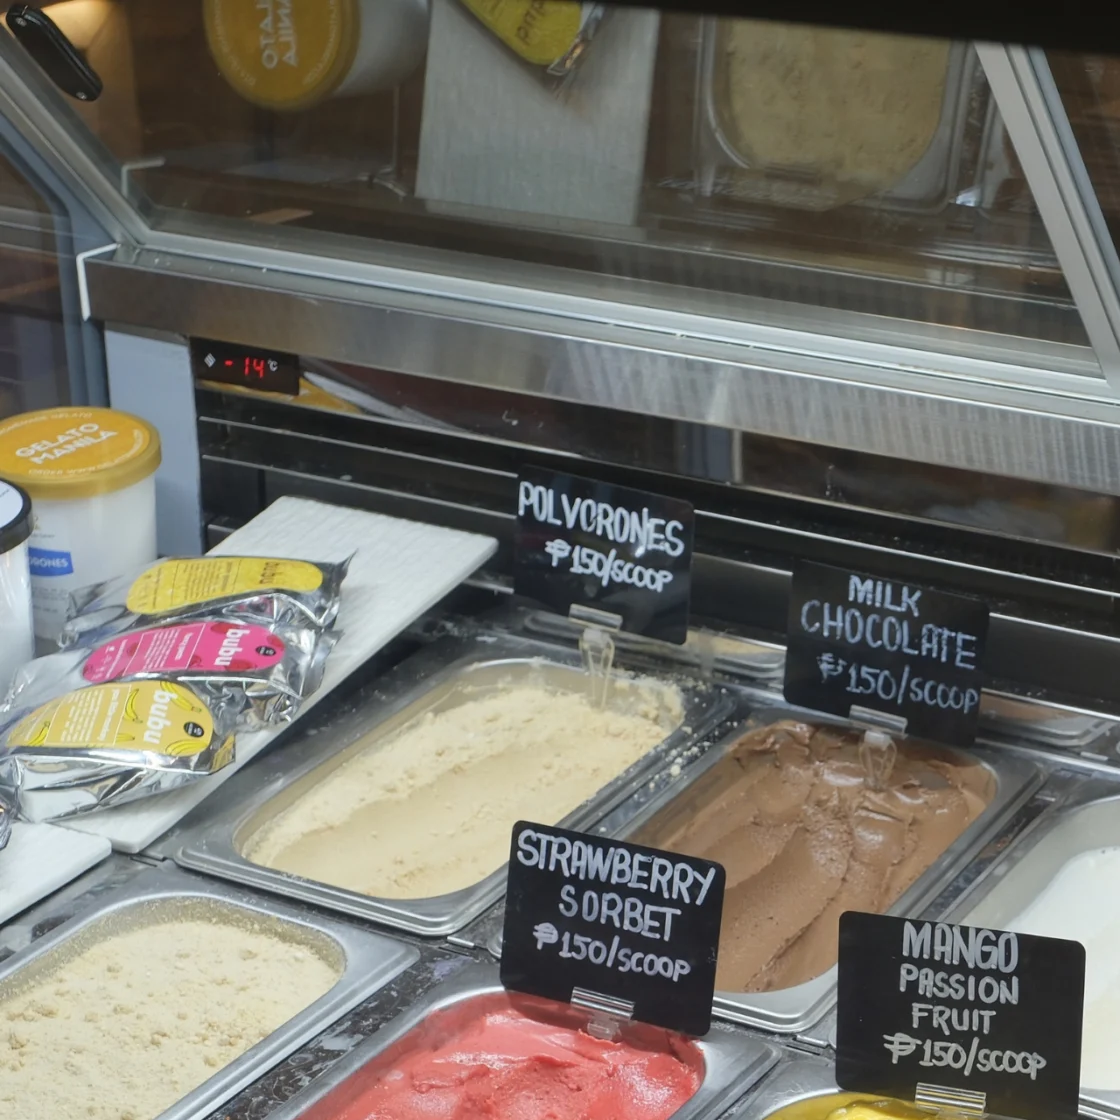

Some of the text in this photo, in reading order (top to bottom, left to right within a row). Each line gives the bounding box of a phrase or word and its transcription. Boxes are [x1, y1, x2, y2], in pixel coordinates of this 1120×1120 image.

[15, 423, 99, 457] GELATO
[30, 430, 118, 464] MANILA
[518, 481, 685, 558] POLVORONES
[848, 575, 922, 617] MILK
[213, 628, 250, 666] bubu
[801, 600, 977, 670] CHOCOLATE
[143, 689, 177, 745] bubu
[517, 829, 716, 906] STRAWBERRY
[558, 885, 681, 941] SORBET
[902, 921, 1019, 973] MANGO
[899, 963, 1019, 1005] PASSION
[911, 1002, 997, 1035] FRUIT
